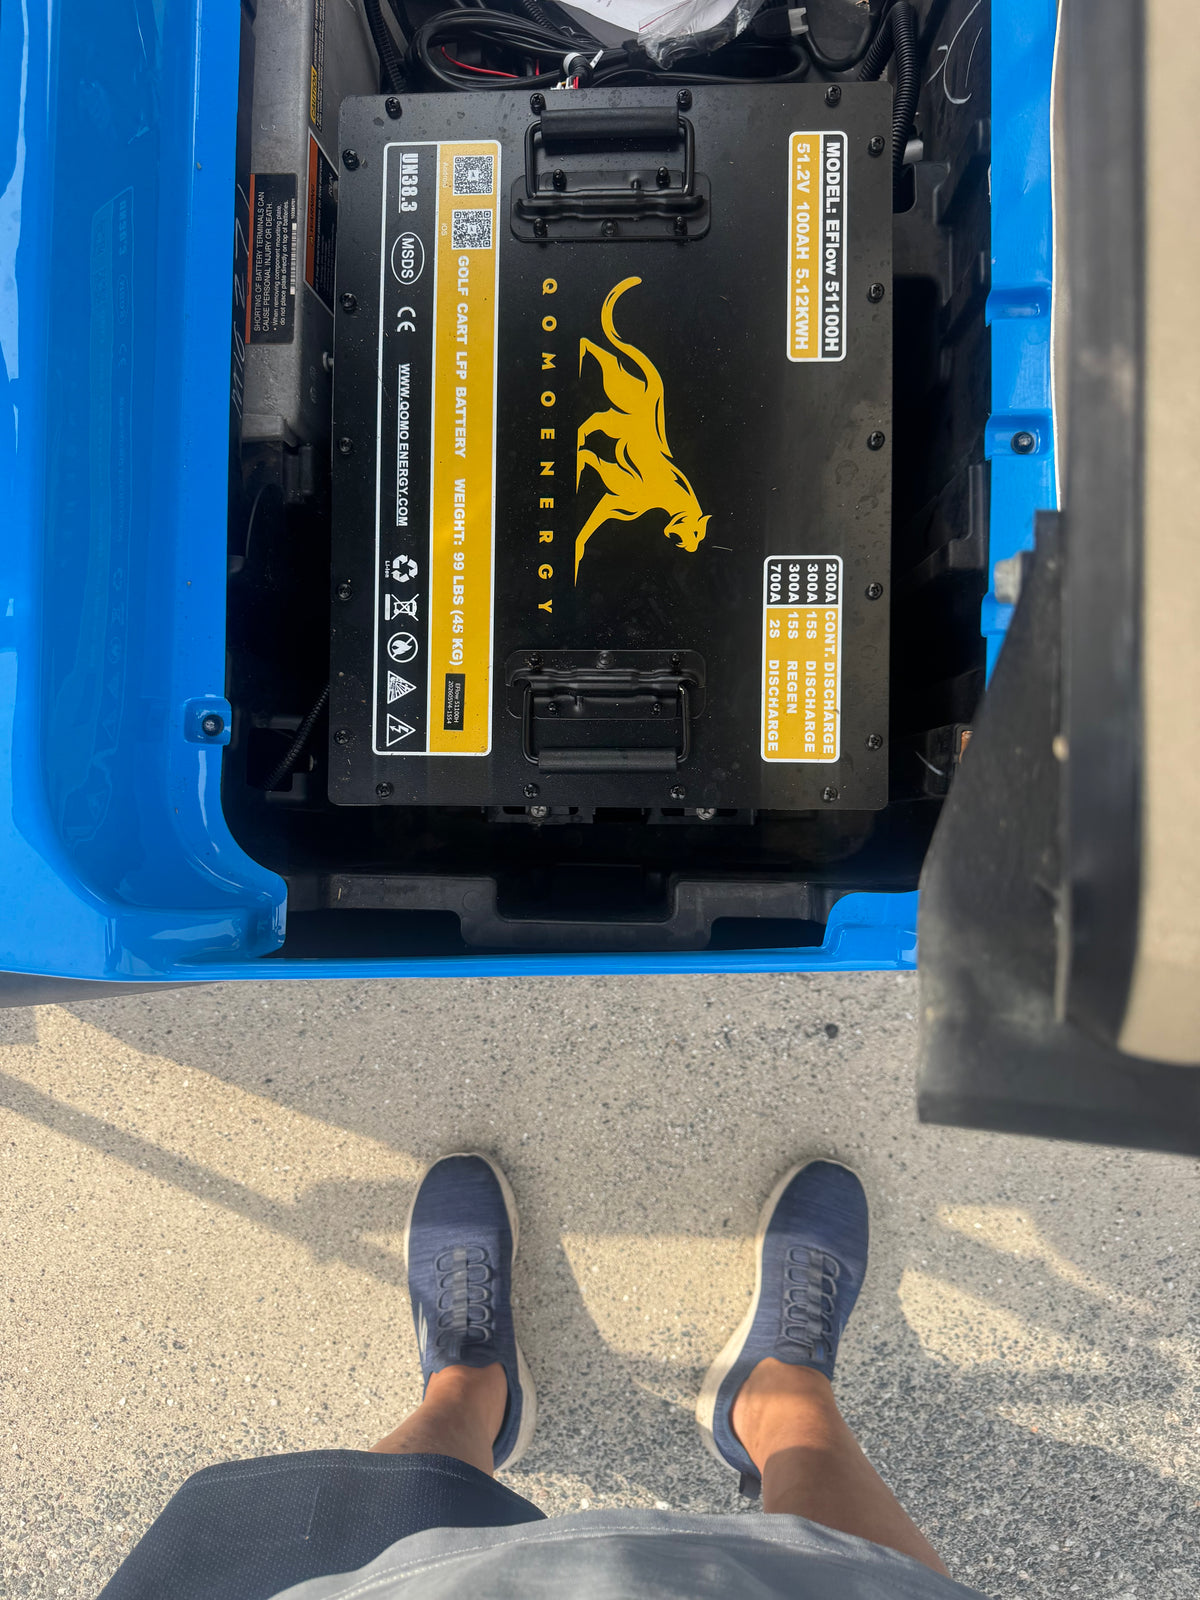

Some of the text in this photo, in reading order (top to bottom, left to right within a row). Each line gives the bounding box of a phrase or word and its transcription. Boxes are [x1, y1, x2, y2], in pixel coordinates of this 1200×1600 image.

[256, 209, 264, 248] TERMINALS
[266, 229, 272, 239] OR
[400, 153, 419, 212] UN38.3
[400, 237, 415, 279] MSDS
[795, 143, 810, 350] 51.2V 100AH 5.12KWH
[825, 142, 841, 351] MODEL: EFlow 51100H
[255, 283, 262, 292] OF
[263, 268, 271, 305] PERSONAL
[449, 255, 469, 666] GOLF CART LFP BATTERY WEIGHT: 99 LBS (45 KG)
[767, 563, 781, 752] 700A 2S DISCHARGE
[786, 563, 799, 714] 300A 15S REGEN
[804, 563, 818, 753] 300A 15S DISCHARGE
[822, 563, 837, 754] 200A CONT. DISCHARGE
